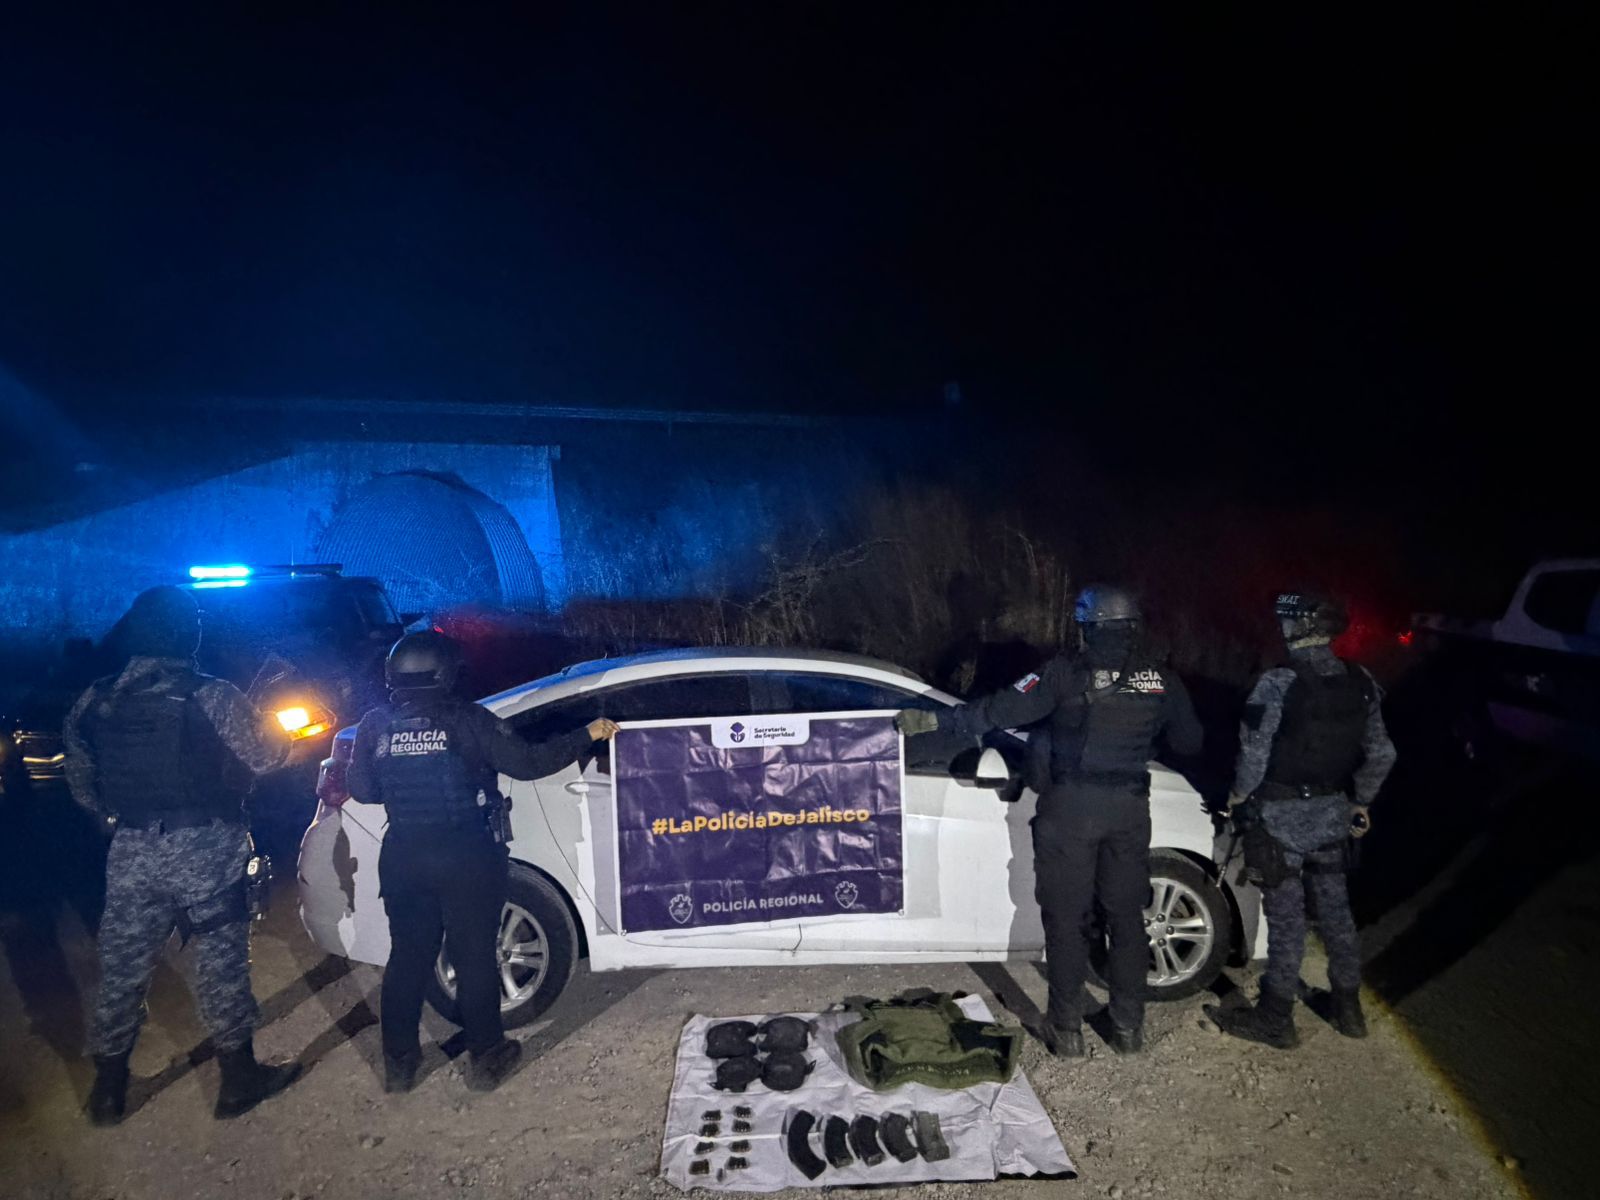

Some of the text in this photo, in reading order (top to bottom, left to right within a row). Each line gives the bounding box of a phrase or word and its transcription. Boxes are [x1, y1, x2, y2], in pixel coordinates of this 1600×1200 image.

[1111, 669, 1162, 682] PLICÍA
[391, 729, 447, 743] POLICÍA
[390, 742, 447, 752] REGIONAL
[703, 897, 757, 914] POLICÍA
[760, 893, 824, 909] REGIONAL
